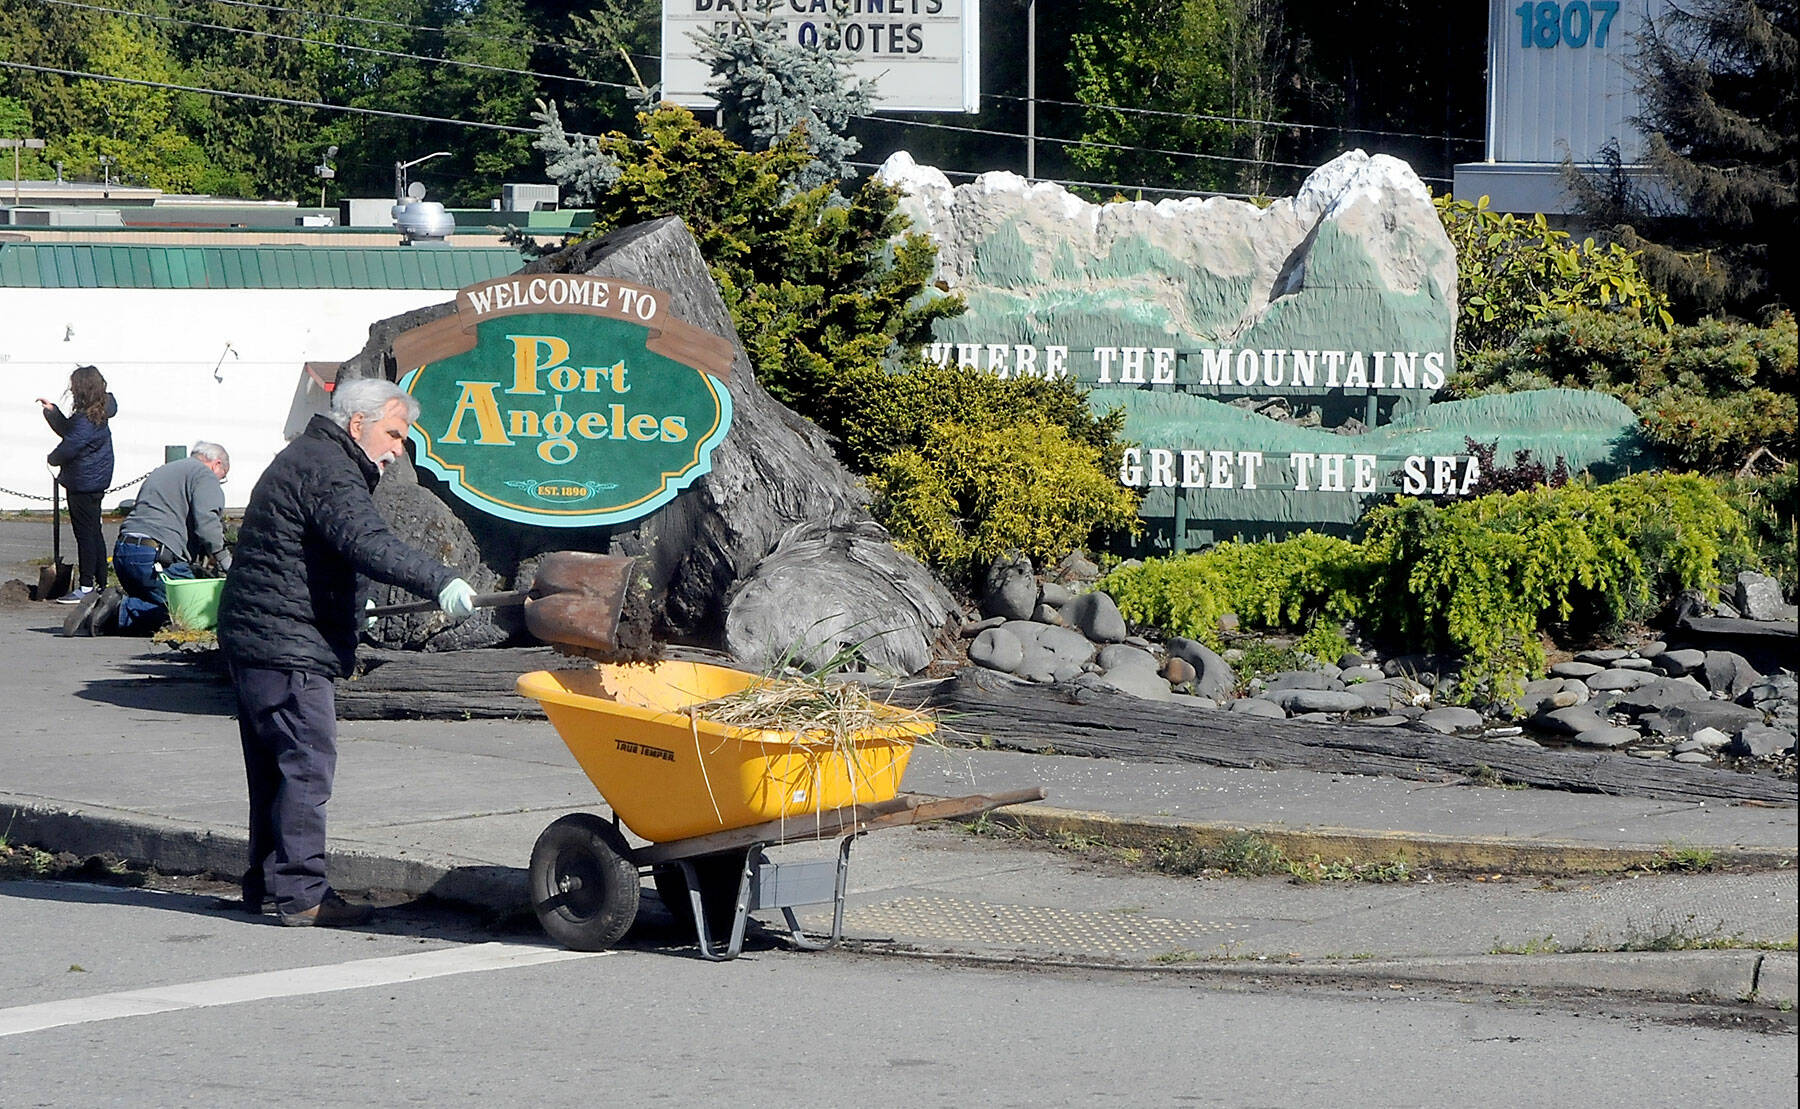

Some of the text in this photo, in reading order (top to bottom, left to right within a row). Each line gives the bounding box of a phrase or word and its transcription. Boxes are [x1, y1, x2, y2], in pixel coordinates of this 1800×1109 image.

[1515, 1, 1619, 48] 1807
[467, 279, 657, 320] WELCOME TO
[505, 335, 632, 395] Port
[1094, 347, 1174, 384] THE
[1200, 349, 1445, 389] MOUNTAINS
[438, 381, 688, 464] Angeles
[538, 486, 587, 496] EST. 1890
[1120, 449, 1481, 495] GREET THE SEA
